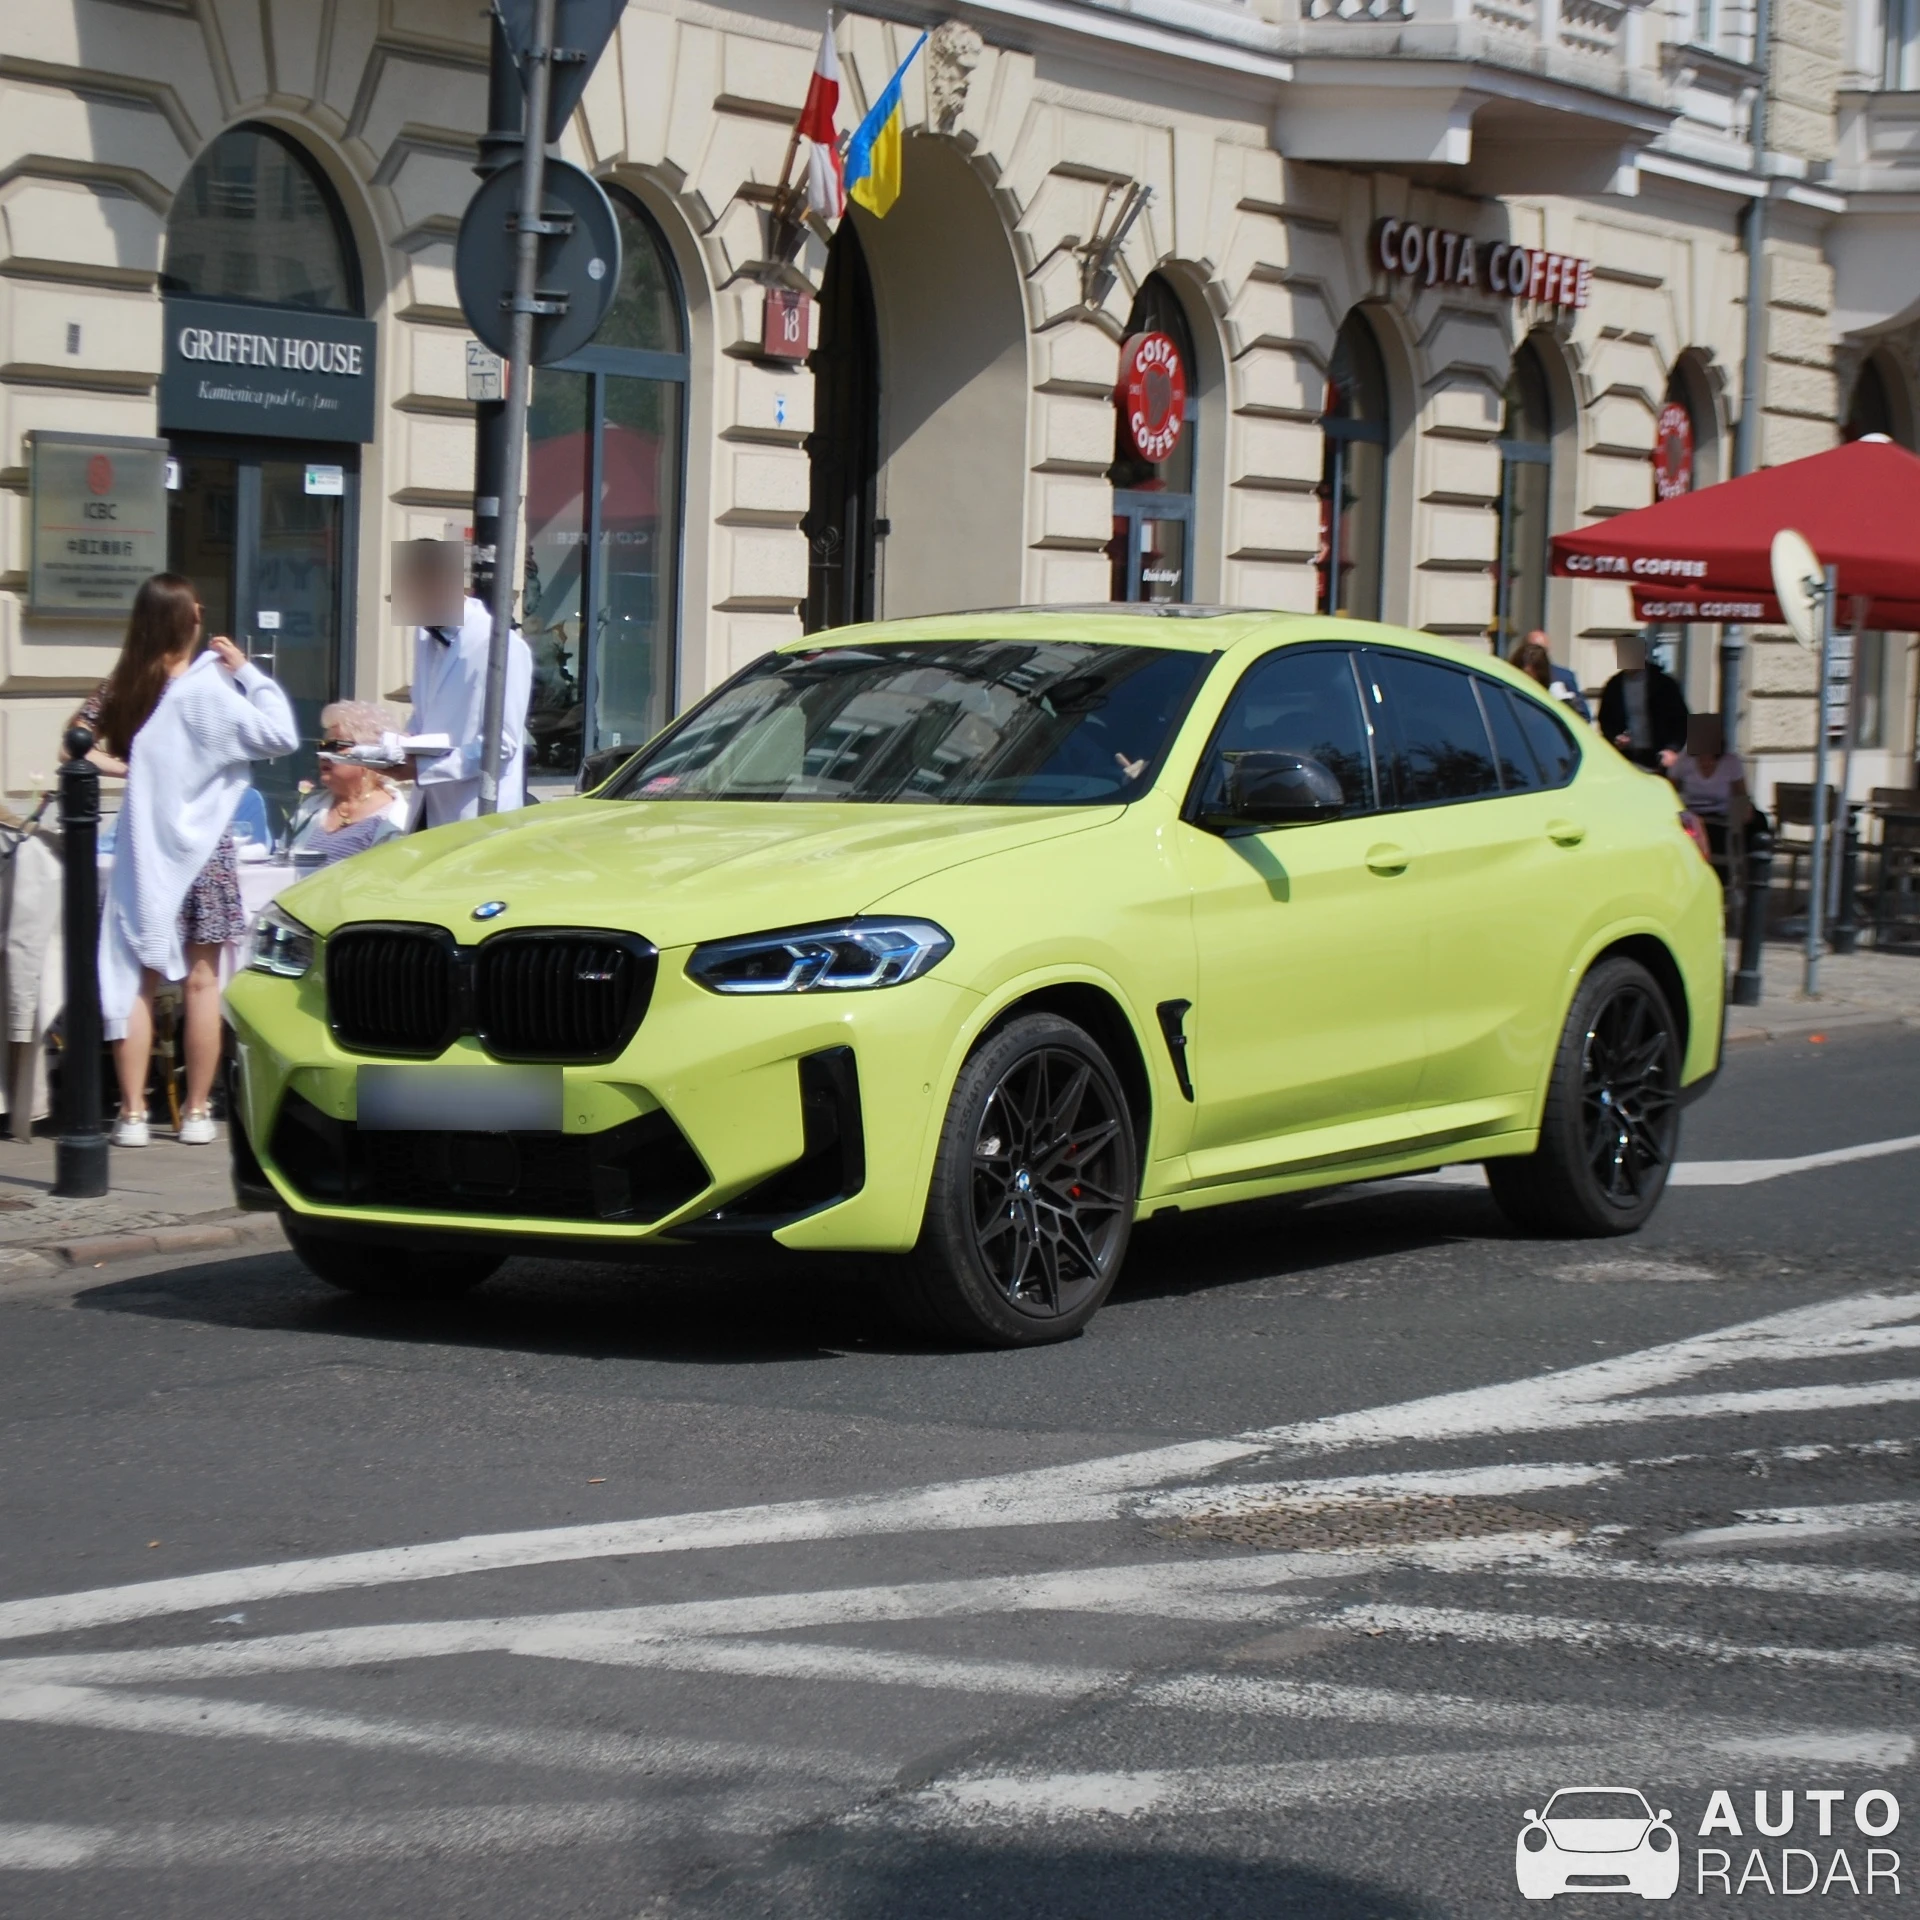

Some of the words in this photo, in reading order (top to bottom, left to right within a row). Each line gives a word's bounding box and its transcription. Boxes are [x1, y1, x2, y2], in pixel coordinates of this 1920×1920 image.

[1380, 219, 1477, 286] COSTA
[1489, 243, 1590, 307] COFFEE
[782, 307, 800, 342] 18
[179, 327, 278, 367] GRIFFIN
[282, 337, 362, 375] HOUSE
[1136, 338, 1178, 378] COSTA
[263, 387, 289, 409] pod
[1132, 411, 1180, 457] COFFEE
[84, 502, 118, 520] ICBC
[1566, 555, 1628, 573] COSTA
[1632, 557, 1708, 577] COFFEE
[1641, 601, 1696, 617] COSTA
[1699, 602, 1765, 618] COFFEE
